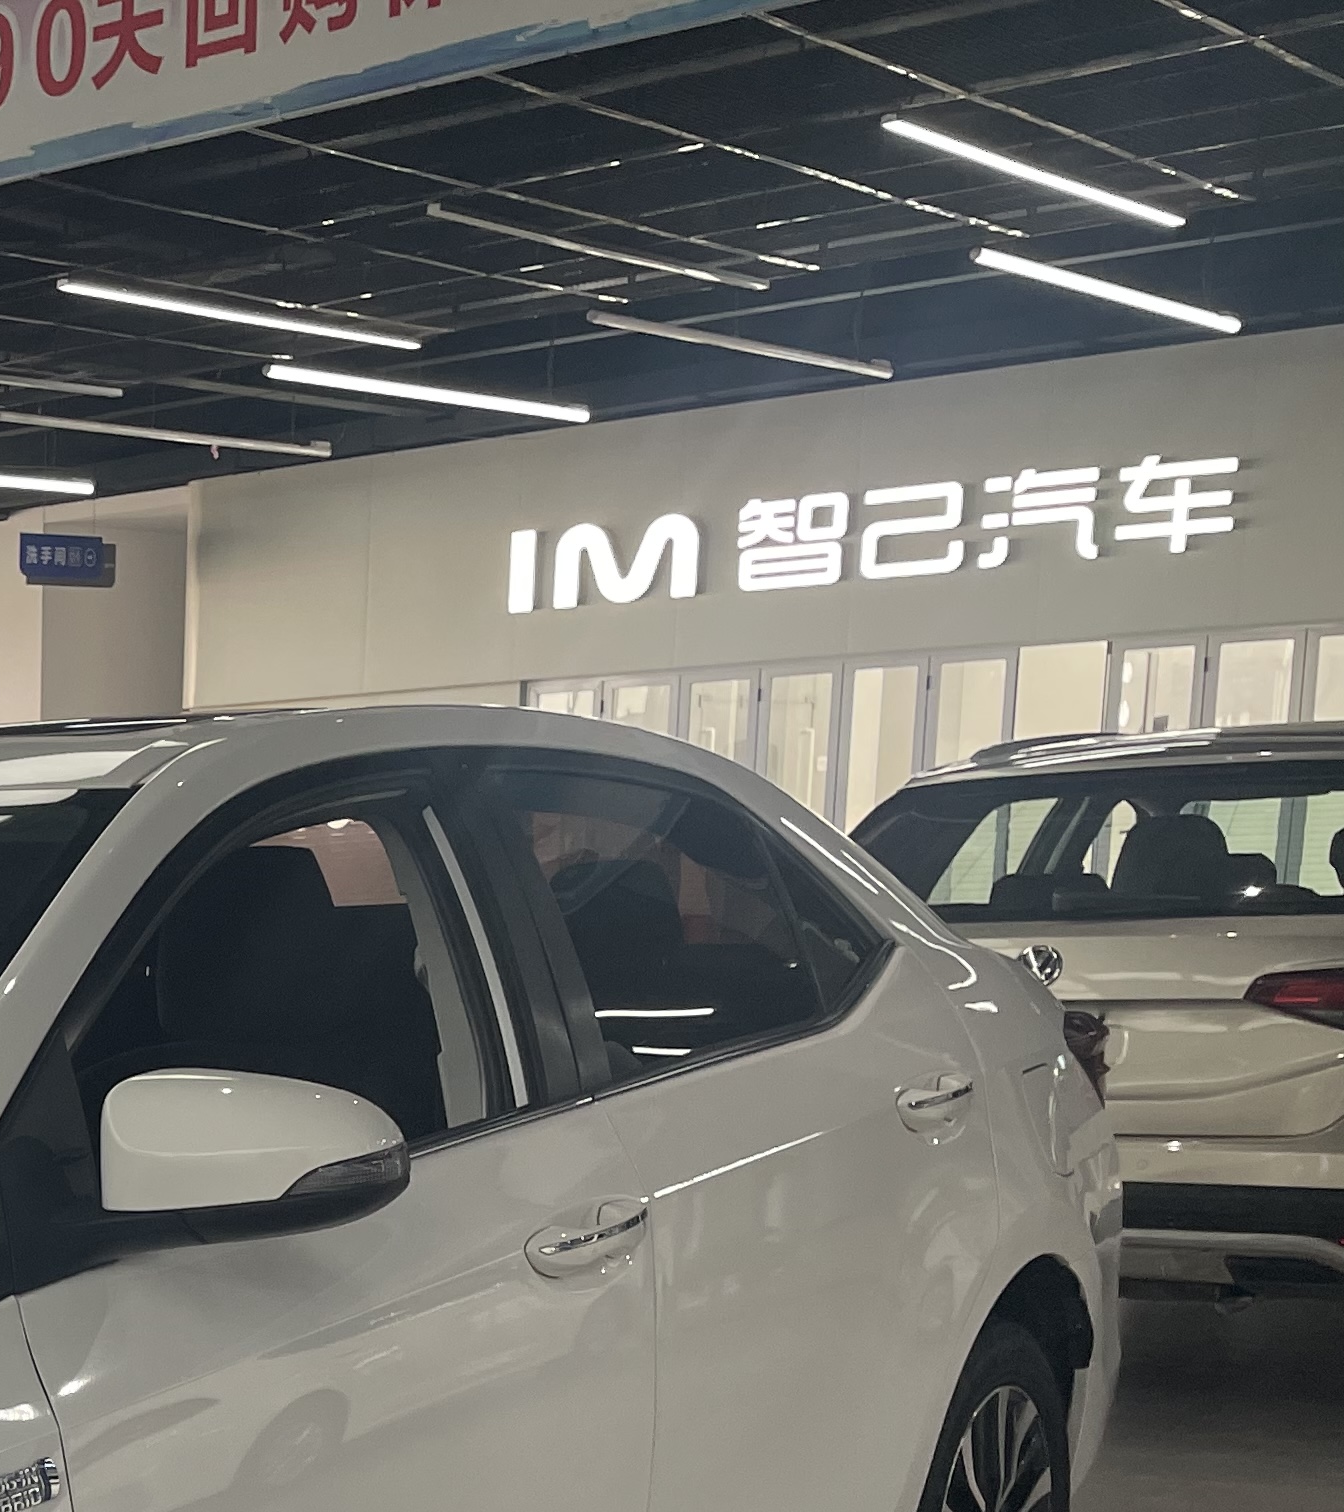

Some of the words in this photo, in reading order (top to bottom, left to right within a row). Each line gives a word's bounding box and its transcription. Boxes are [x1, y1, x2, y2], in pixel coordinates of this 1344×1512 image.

[25, 544, 67, 566] 洗手间
[508, 512, 701, 614] IM
[736, 454, 1240, 592] 智己汽车
